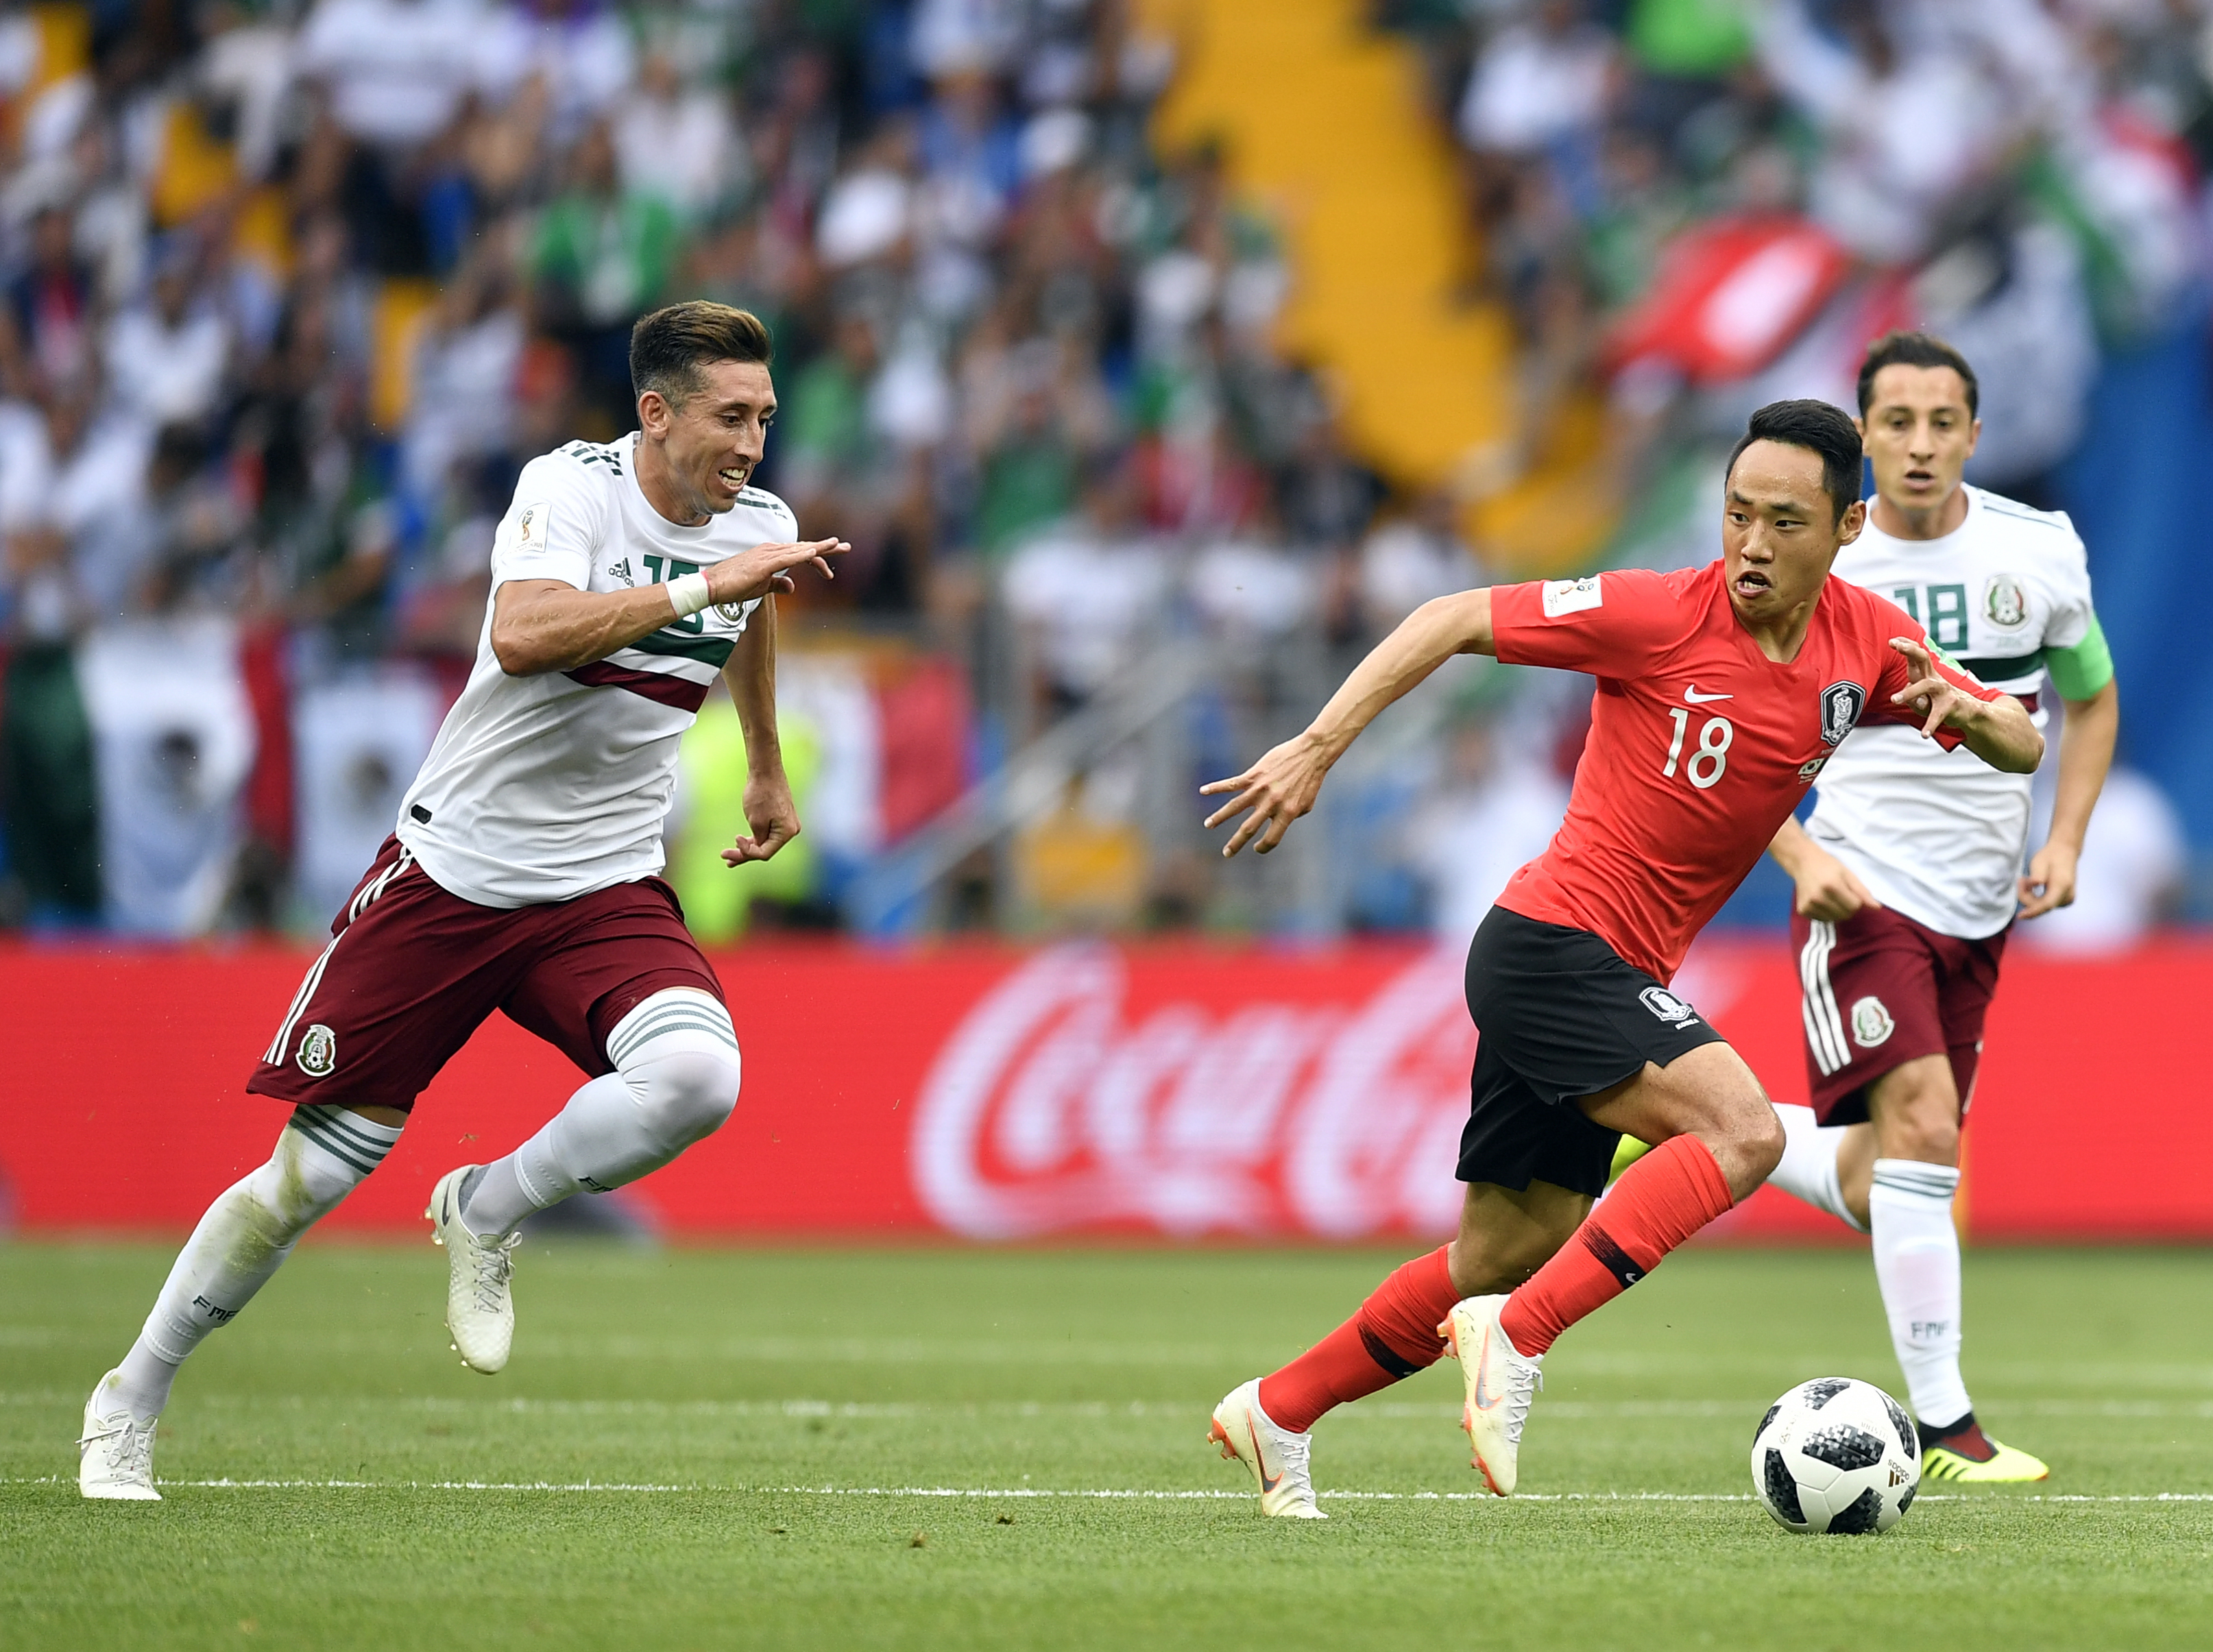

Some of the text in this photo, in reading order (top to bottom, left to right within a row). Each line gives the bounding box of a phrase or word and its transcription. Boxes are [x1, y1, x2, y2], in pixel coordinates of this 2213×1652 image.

[608, 568, 635, 588] adias
[1894, 584, 1969, 651] 18
[1662, 707, 1734, 789] 18
[192, 1294, 240, 1322] FMF
[1887, 1459, 1910, 1481] adidas
